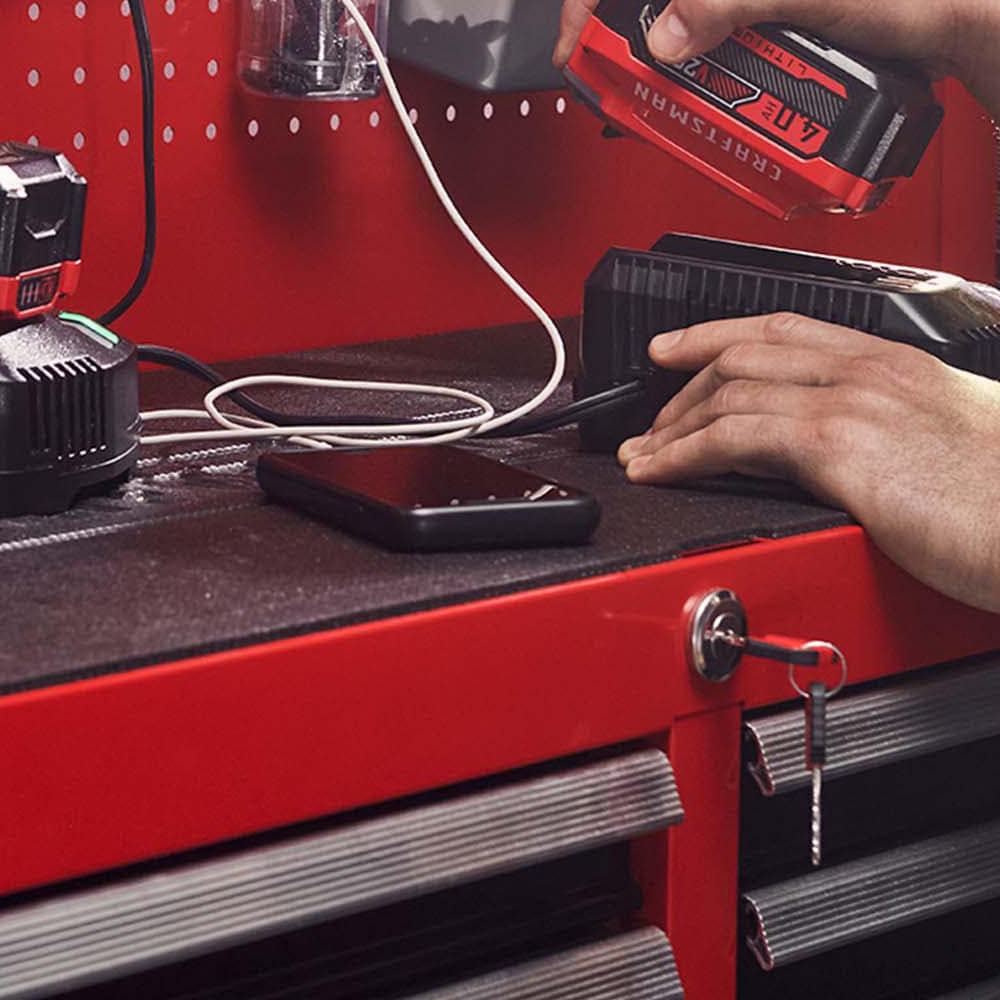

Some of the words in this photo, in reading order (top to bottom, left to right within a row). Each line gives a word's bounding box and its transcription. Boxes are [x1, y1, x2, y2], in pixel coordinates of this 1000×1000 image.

[733, 27, 808, 76] LITHIU
[634, 82, 783, 181] CRAFTSMAN
[774, 106, 821, 143] 4.0
